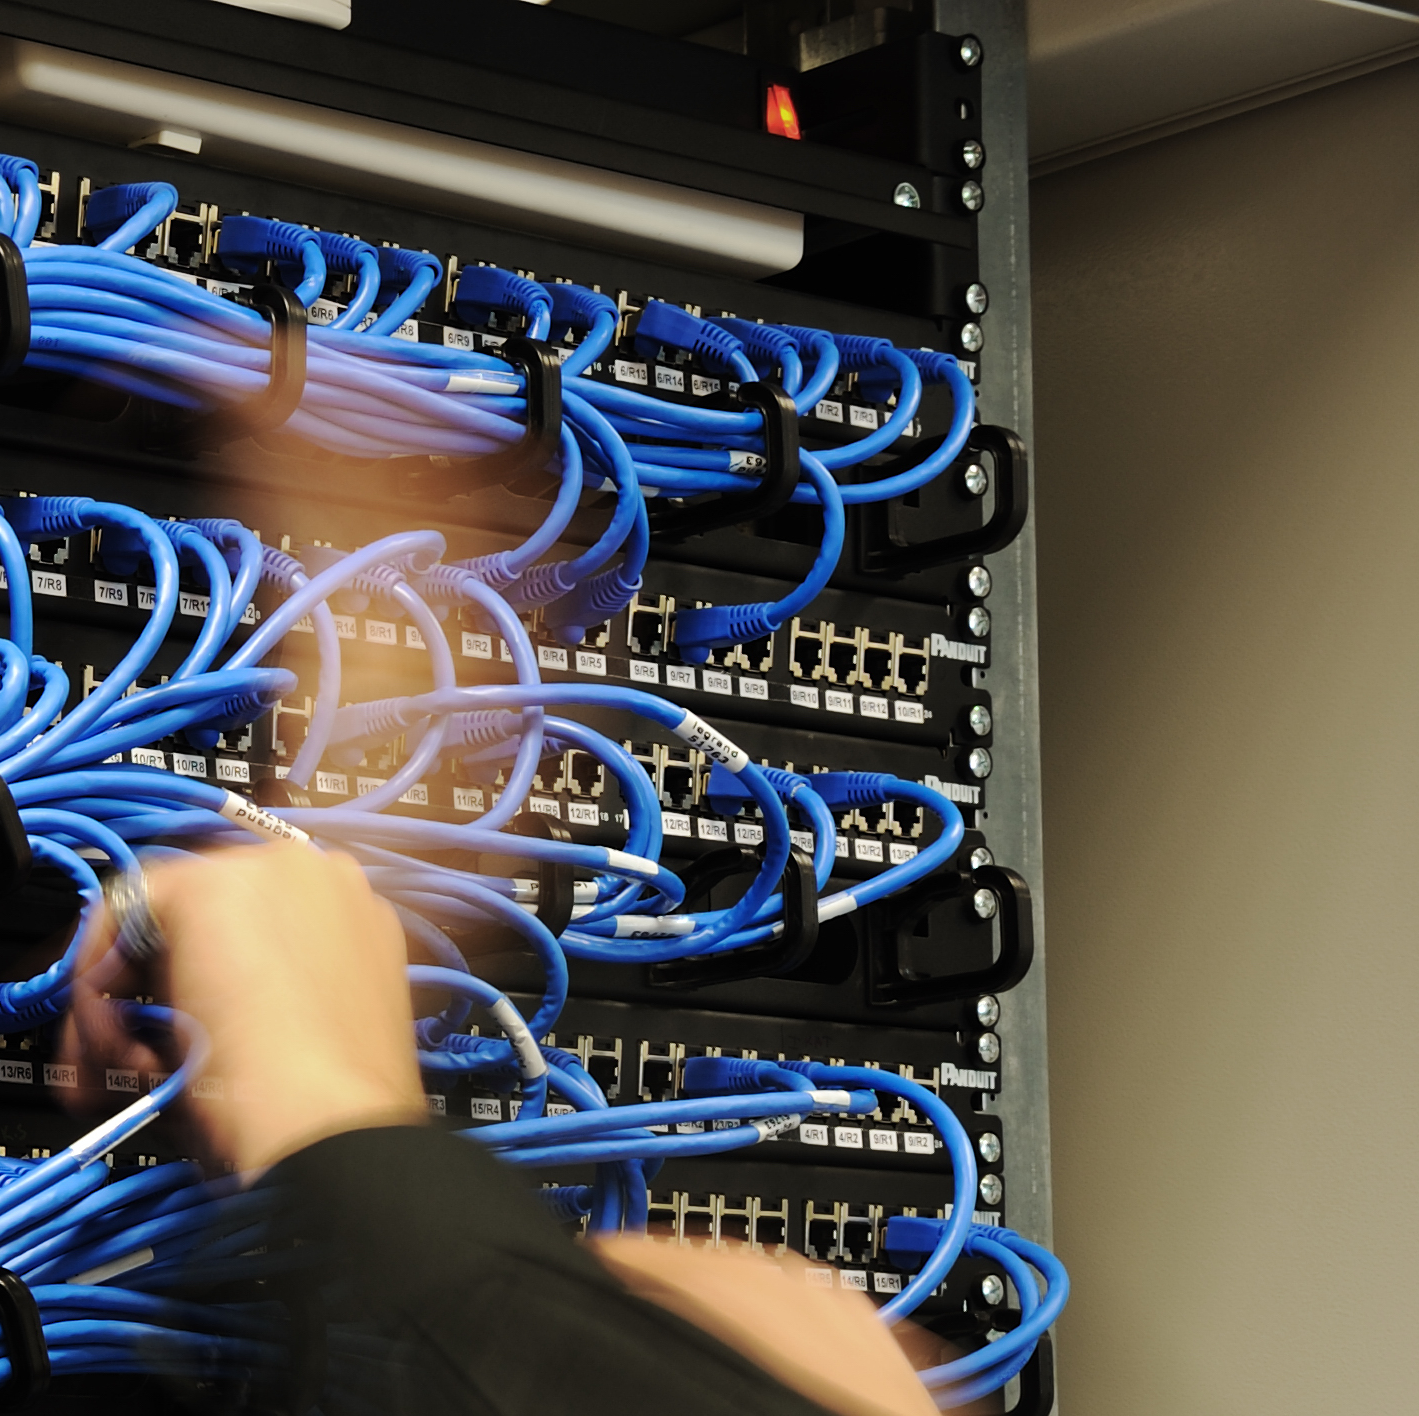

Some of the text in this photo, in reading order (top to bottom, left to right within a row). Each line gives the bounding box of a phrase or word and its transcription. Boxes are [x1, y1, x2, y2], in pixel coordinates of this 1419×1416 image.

[311, 308, 333, 320] 6/R6
[448, 333, 469, 346] 6/R9
[621, 365, 646, 380] 6/R13
[657, 371, 682, 387] 6/R14
[819, 403, 839, 418] 7/R2
[854, 409, 874, 424] 7/R3
[37, 576, 62, 590] 7/R8
[99, 587, 123, 600] 7/R9
[370, 626, 392, 639] 8/R1
[466, 639, 488, 652] 9/R2
[931, 633, 987, 664] PANDUIT
[543, 651, 564, 662] 9/R4
[581, 656, 602, 668] 9/R5
[635, 664, 655, 678] 9/R6
[670, 669, 691, 684] 9/R7
[707, 676, 728, 690] 9/R8
[745, 682, 765, 696] 9/R9
[792, 689, 817, 704] 9/R10
[828, 696, 852, 711] 9/R11
[862, 701, 887, 715] 9/R12
[898, 707, 922, 720] 10/R1
[691, 720, 739, 759] legrand
[687, 735, 730, 764] 51763
[175, 758, 205, 772] 10/R8
[218, 764, 248, 778] 10/R9
[318, 776, 346, 791] 11/R1
[457, 795, 483, 808] 11/R4
[571, 808, 596, 821] 12/R1
[665, 819, 689, 831] 12/R3
[1, 1064, 32, 1080] 13/R6
[45, 1069, 76, 1084] 14/R1
[941, 1062, 997, 1089] PANDUIT
[108, 1074, 138, 1089] 14/R2
[473, 1103, 500, 1116] 15/R4
[805, 1127, 824, 1141] 4/R1
[839, 1132, 858, 1144] 4/R2
[873, 1134, 893, 1147] 9/R1
[908, 1137, 928, 1149] 9/R2
[876, 1276, 900, 1289] 15/R1
